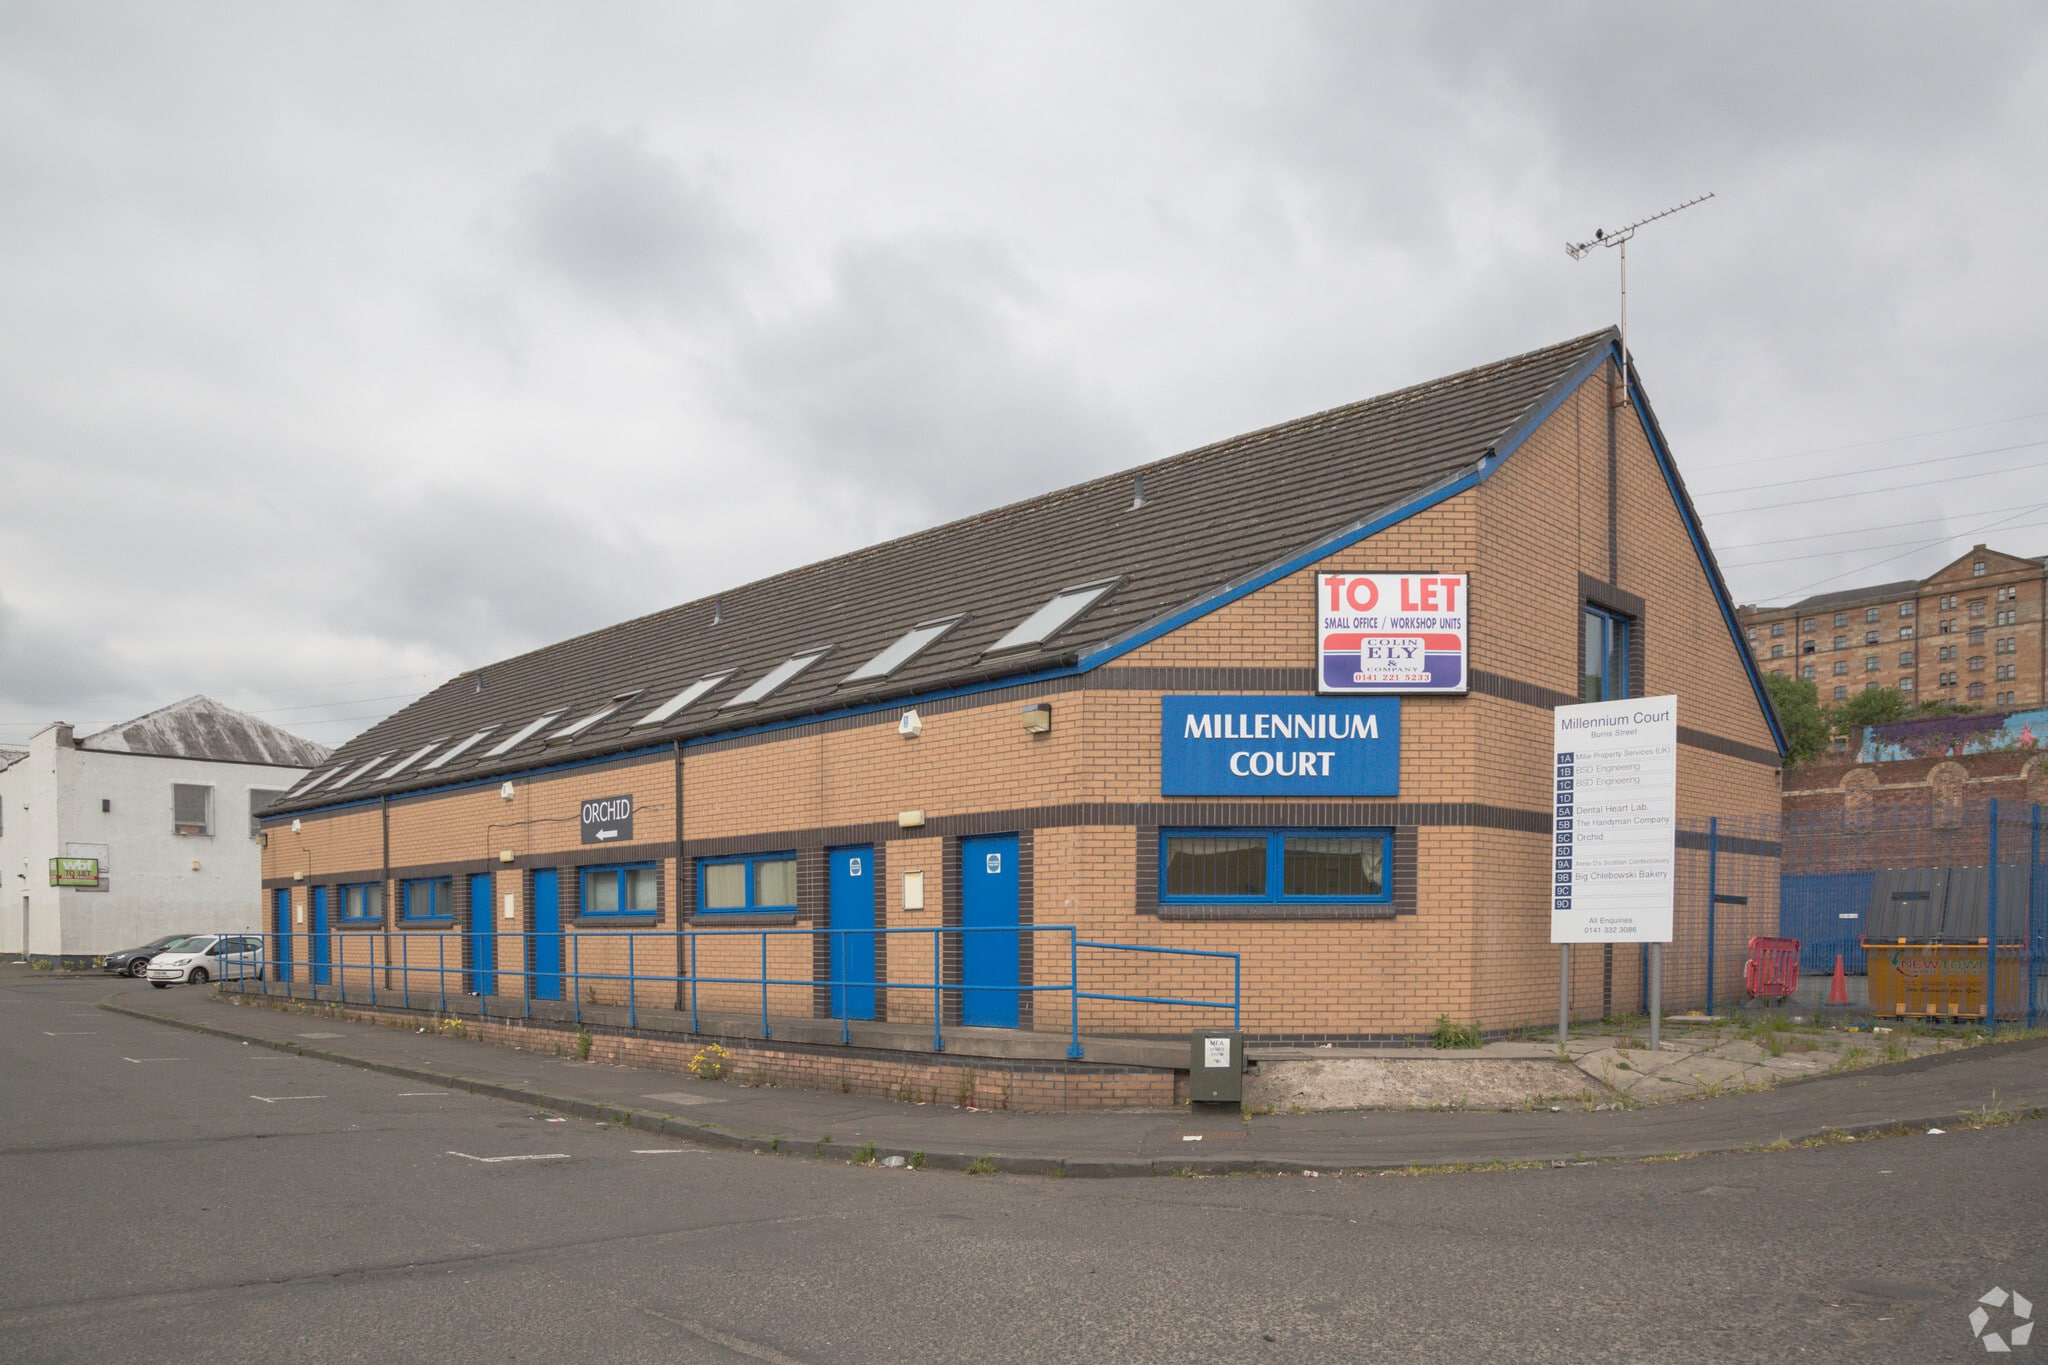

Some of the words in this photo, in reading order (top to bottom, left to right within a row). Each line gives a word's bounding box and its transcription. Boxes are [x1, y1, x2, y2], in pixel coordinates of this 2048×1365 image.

[1324, 577, 1379, 612] TO
[1400, 577, 1461, 612] LET
[1324, 617, 1350, 630] SMALL
[1353, 617, 1378, 629] OFFICE
[1381, 616, 1387, 630] /
[1390, 617, 1437, 629] WORKSHOP
[1439, 617, 1462, 630] UNITS
[1367, 647, 1419, 659] ELY
[1183, 713, 1379, 739] MILLENNIUM
[1561, 715, 1629, 730] Millennium
[1633, 710, 1670, 724] Court
[1591, 731, 1613, 739] Burns
[1614, 728, 1638, 736] Street
[1560, 755, 1572, 763] 1A
[1593, 751, 1621, 760] Property
[1623, 748, 1654, 757] Services
[1655, 746, 1671, 755] (UK)
[1229, 751, 1335, 777] COURT
[1560, 768, 1571, 776] 1B
[1576, 765, 1594, 774] BSD
[1596, 763, 1641, 773] Engineering
[1559, 781, 1572, 789] 1C
[1576, 778, 1594, 787] BSD
[1596, 776, 1641, 786] Engineering
[1559, 794, 1572, 803] 1D
[582, 799, 630, 824] ORCHID
[1558, 807, 1571, 816] 5A
[1576, 806, 1603, 815] Dental
[1605, 804, 1628, 813] Heart
[1558, 820, 1570, 829] 5B
[1576, 819, 1590, 827] The
[1592, 818, 1632, 828] Handyman
[1634, 816, 1670, 826] Company
[1558, 834, 1570, 842] 5C
[1576, 832, 1604, 842] Orchid
[1557, 847, 1570, 856] 5D
[1557, 860, 1570, 869] 9A
[1557, 873, 1569, 882] 9B
[1575, 872, 1589, 881] Big
[1590, 870, 1637, 880] Chlebowski
[1639, 870, 1668, 879] Bakery
[1556, 886, 1569, 895] 9C
[1556, 899, 1569, 908] 9D
